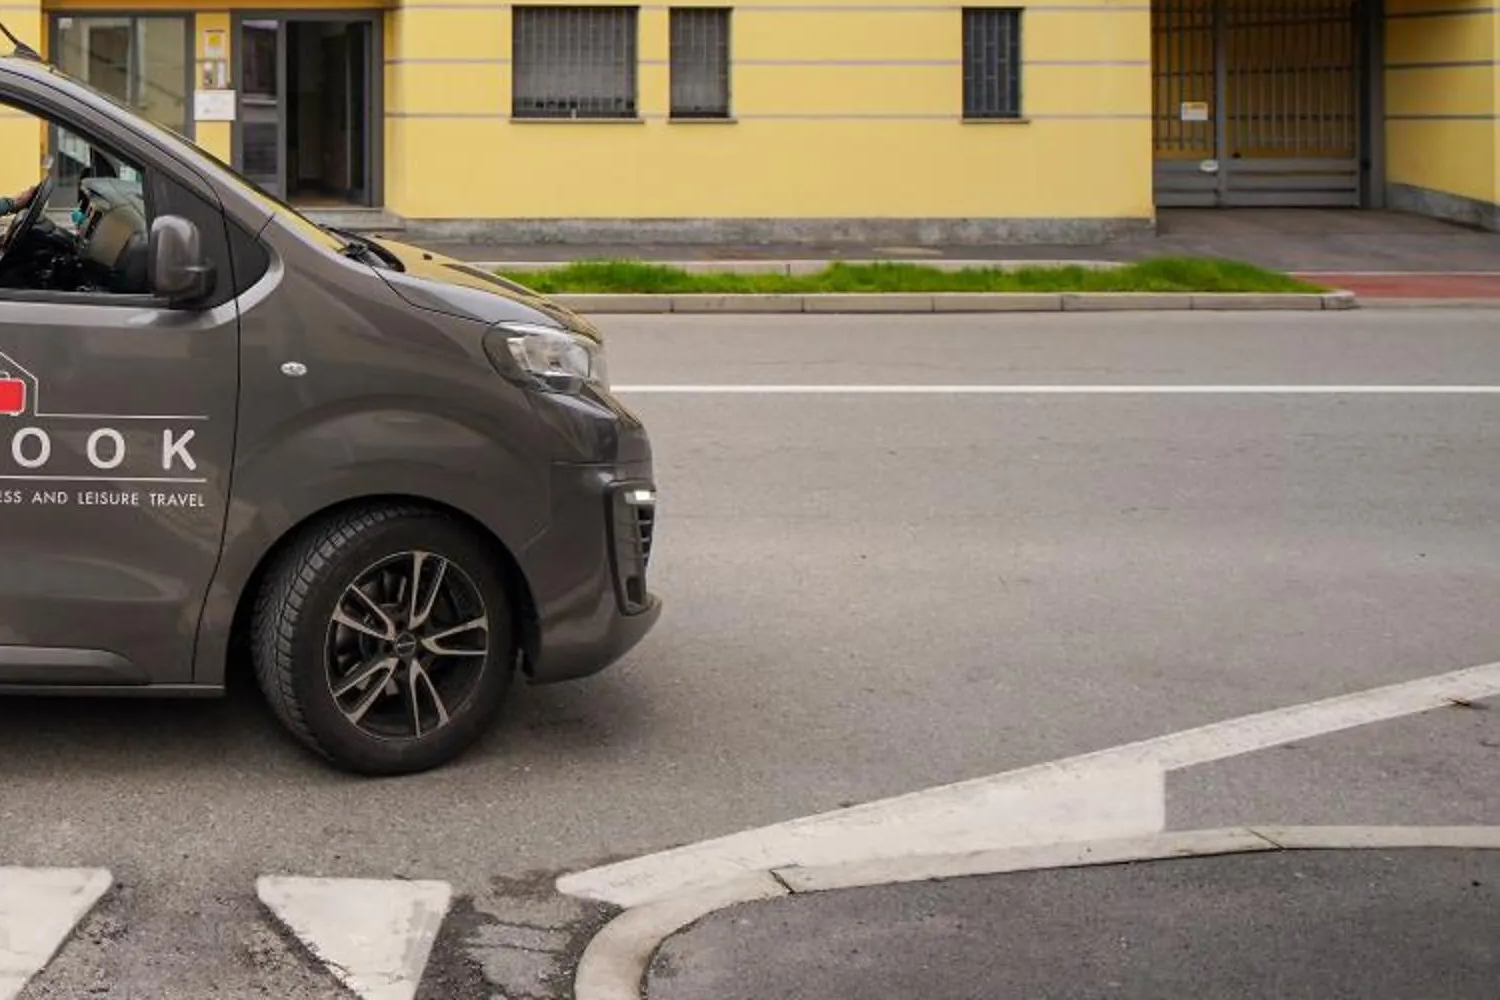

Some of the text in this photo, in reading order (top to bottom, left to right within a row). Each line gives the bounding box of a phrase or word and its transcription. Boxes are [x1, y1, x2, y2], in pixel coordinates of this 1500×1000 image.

[32, 491, 69, 505] AND
[77, 491, 139, 505] LEISURE
[150, 493, 205, 507] TRAVEL
